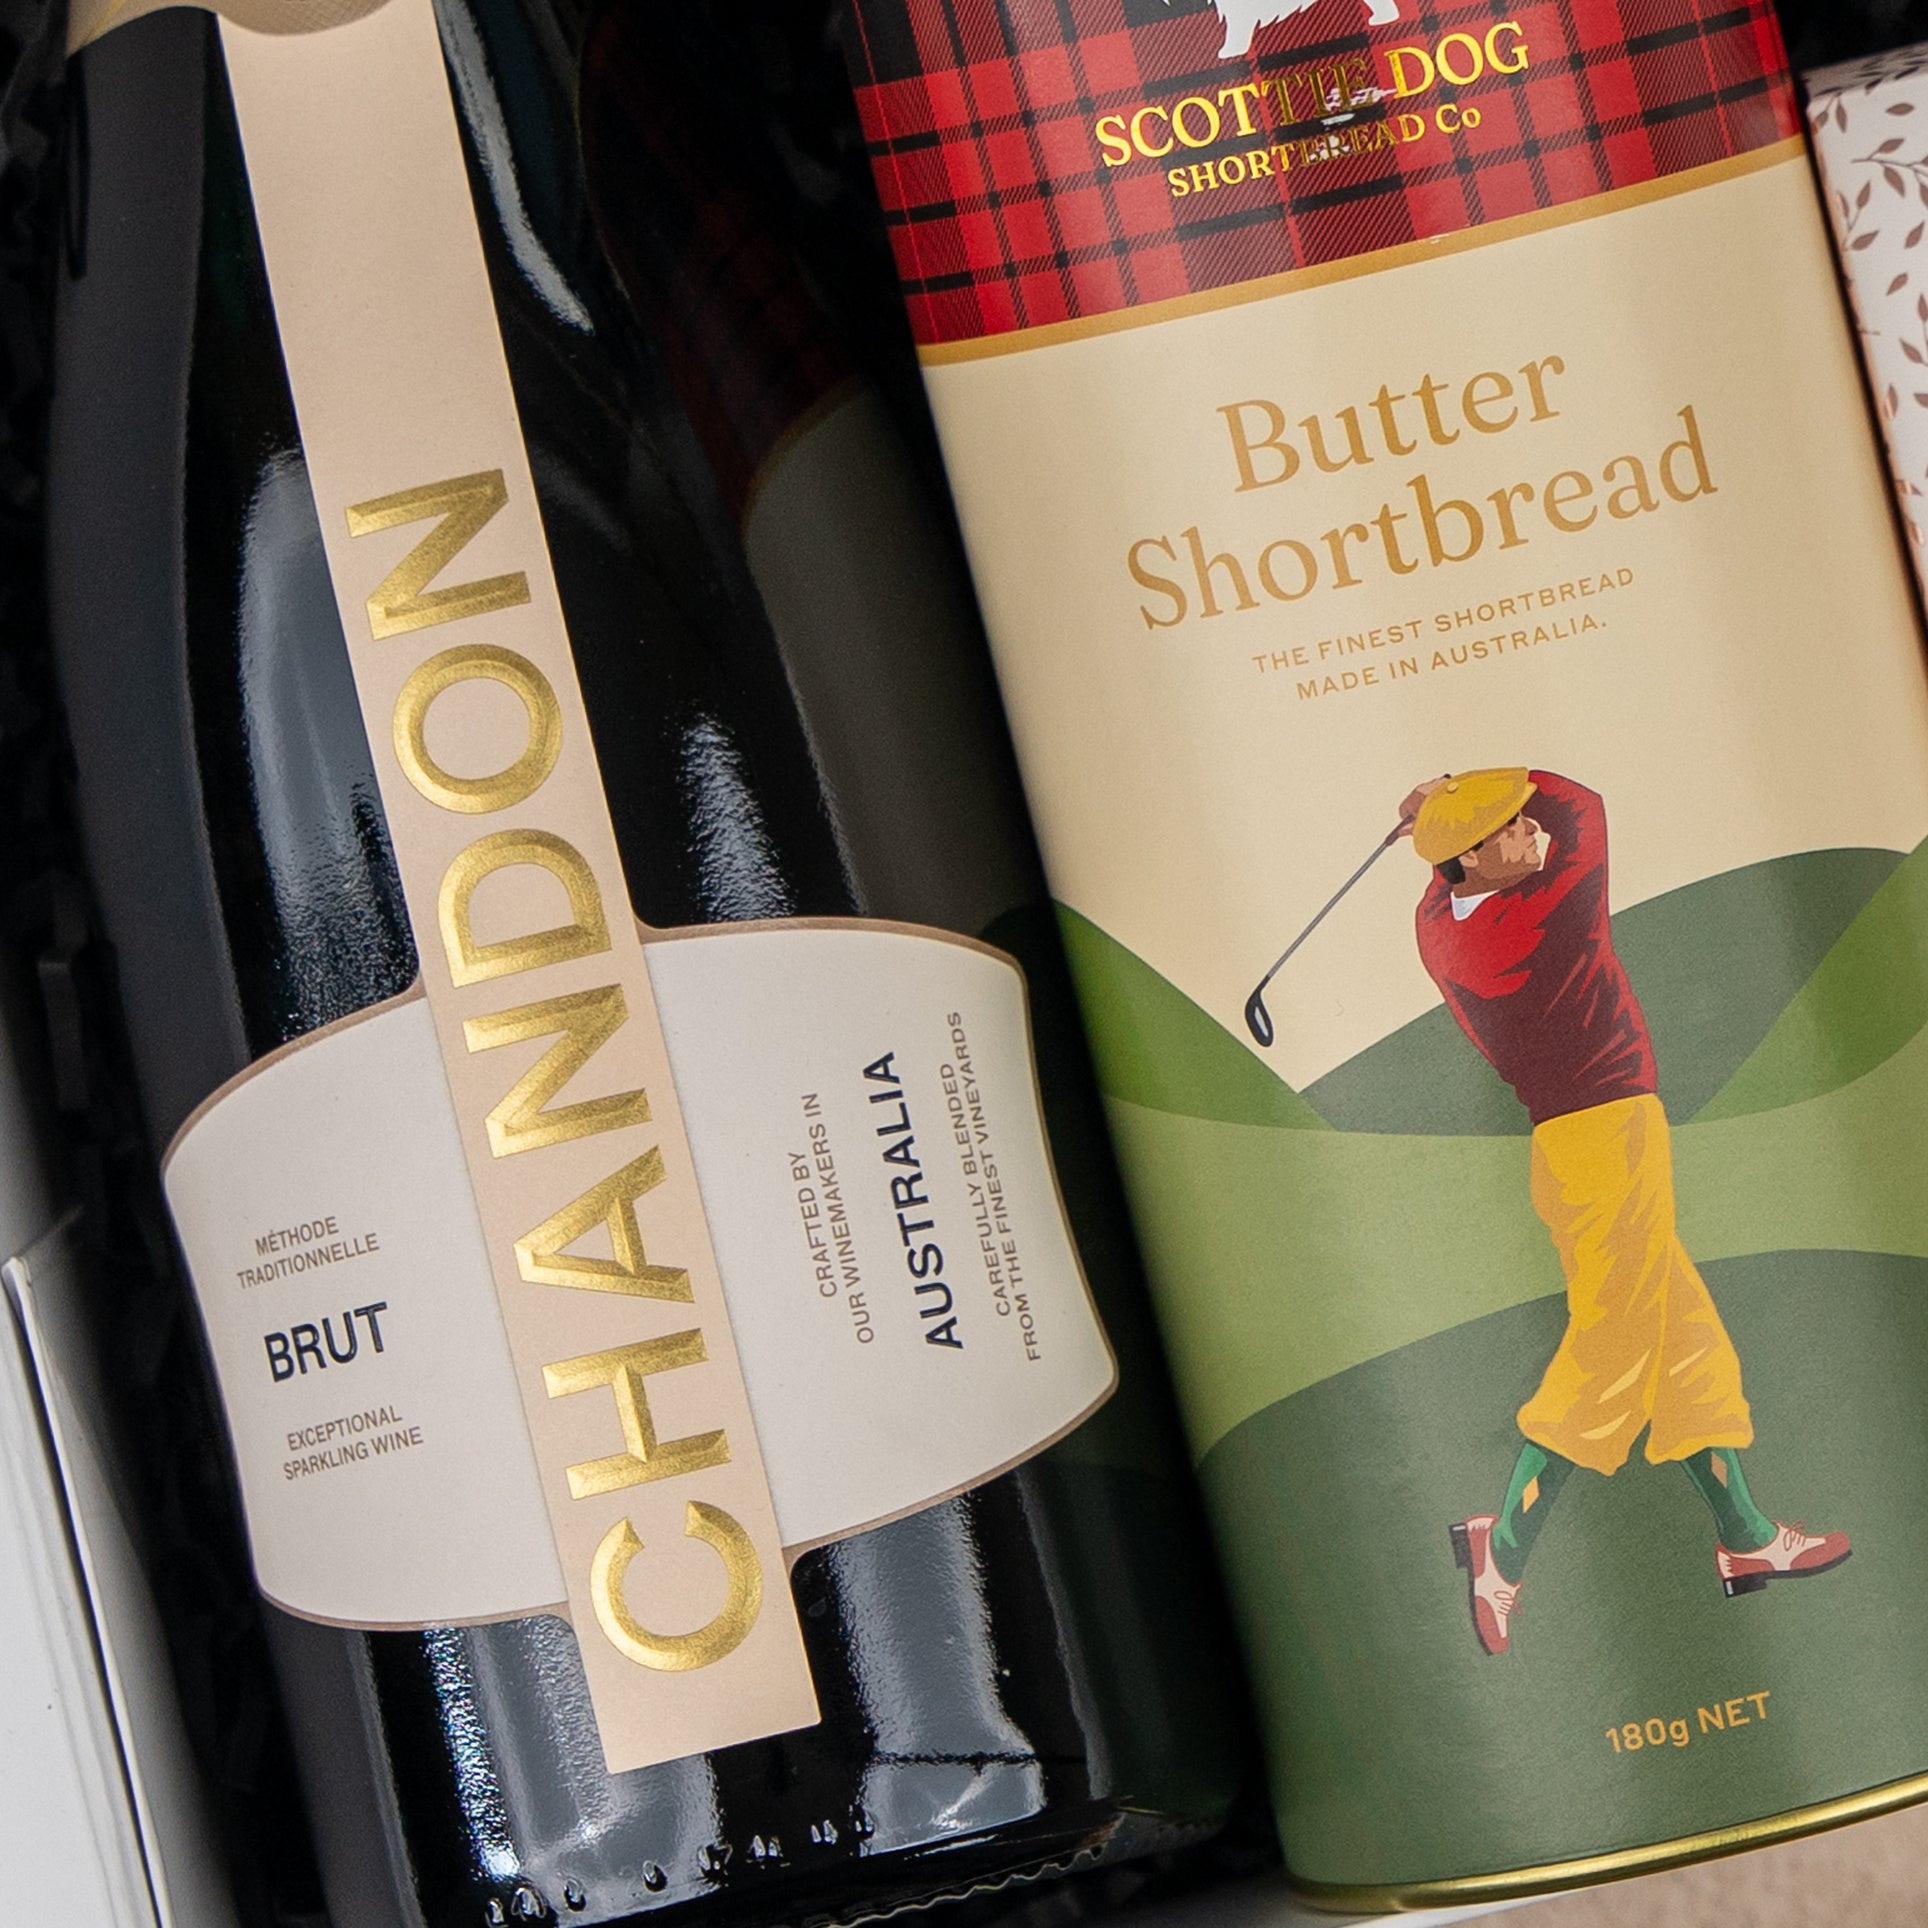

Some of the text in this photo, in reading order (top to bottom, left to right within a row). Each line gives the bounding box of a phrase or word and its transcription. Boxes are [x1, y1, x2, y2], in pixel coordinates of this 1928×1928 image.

[1095, 20, 1529, 167] SCOTTIE DOG
[1167, 103, 1481, 197] SHORTBREAD Co
[1215, 354, 1565, 493] Butter
[1126, 404, 1719, 631] Shortbread
[1251, 567, 1635, 674] THE FINEST SHORTBREAD
[1295, 614, 1608, 701] MADE IN AUSTRALIA.
[344, 467, 764, 1673] CHANDON
[255, 1216, 339, 1256] MÉTHODE
[788, 1151, 838, 1298] CRAFTED BY
[801, 1093, 875, 1344] OUR WINEMAKERS IN
[862, 1051, 964, 1350] AUSTRALIA
[941, 1063, 1011, 1317] CAREFULLY BLENDED
[947, 1011, 1042, 1362] FROM THE FINEST VINEYARDS
[237, 1232, 380, 1290] TRADITIONNELLE
[264, 1301, 388, 1383] BRUT
[283, 1426, 424, 1481] SPARKLING WINE
[287, 1405, 402, 1451] EXCEPTIONAL
[1605, 1690, 1770, 1753] 180g NET
